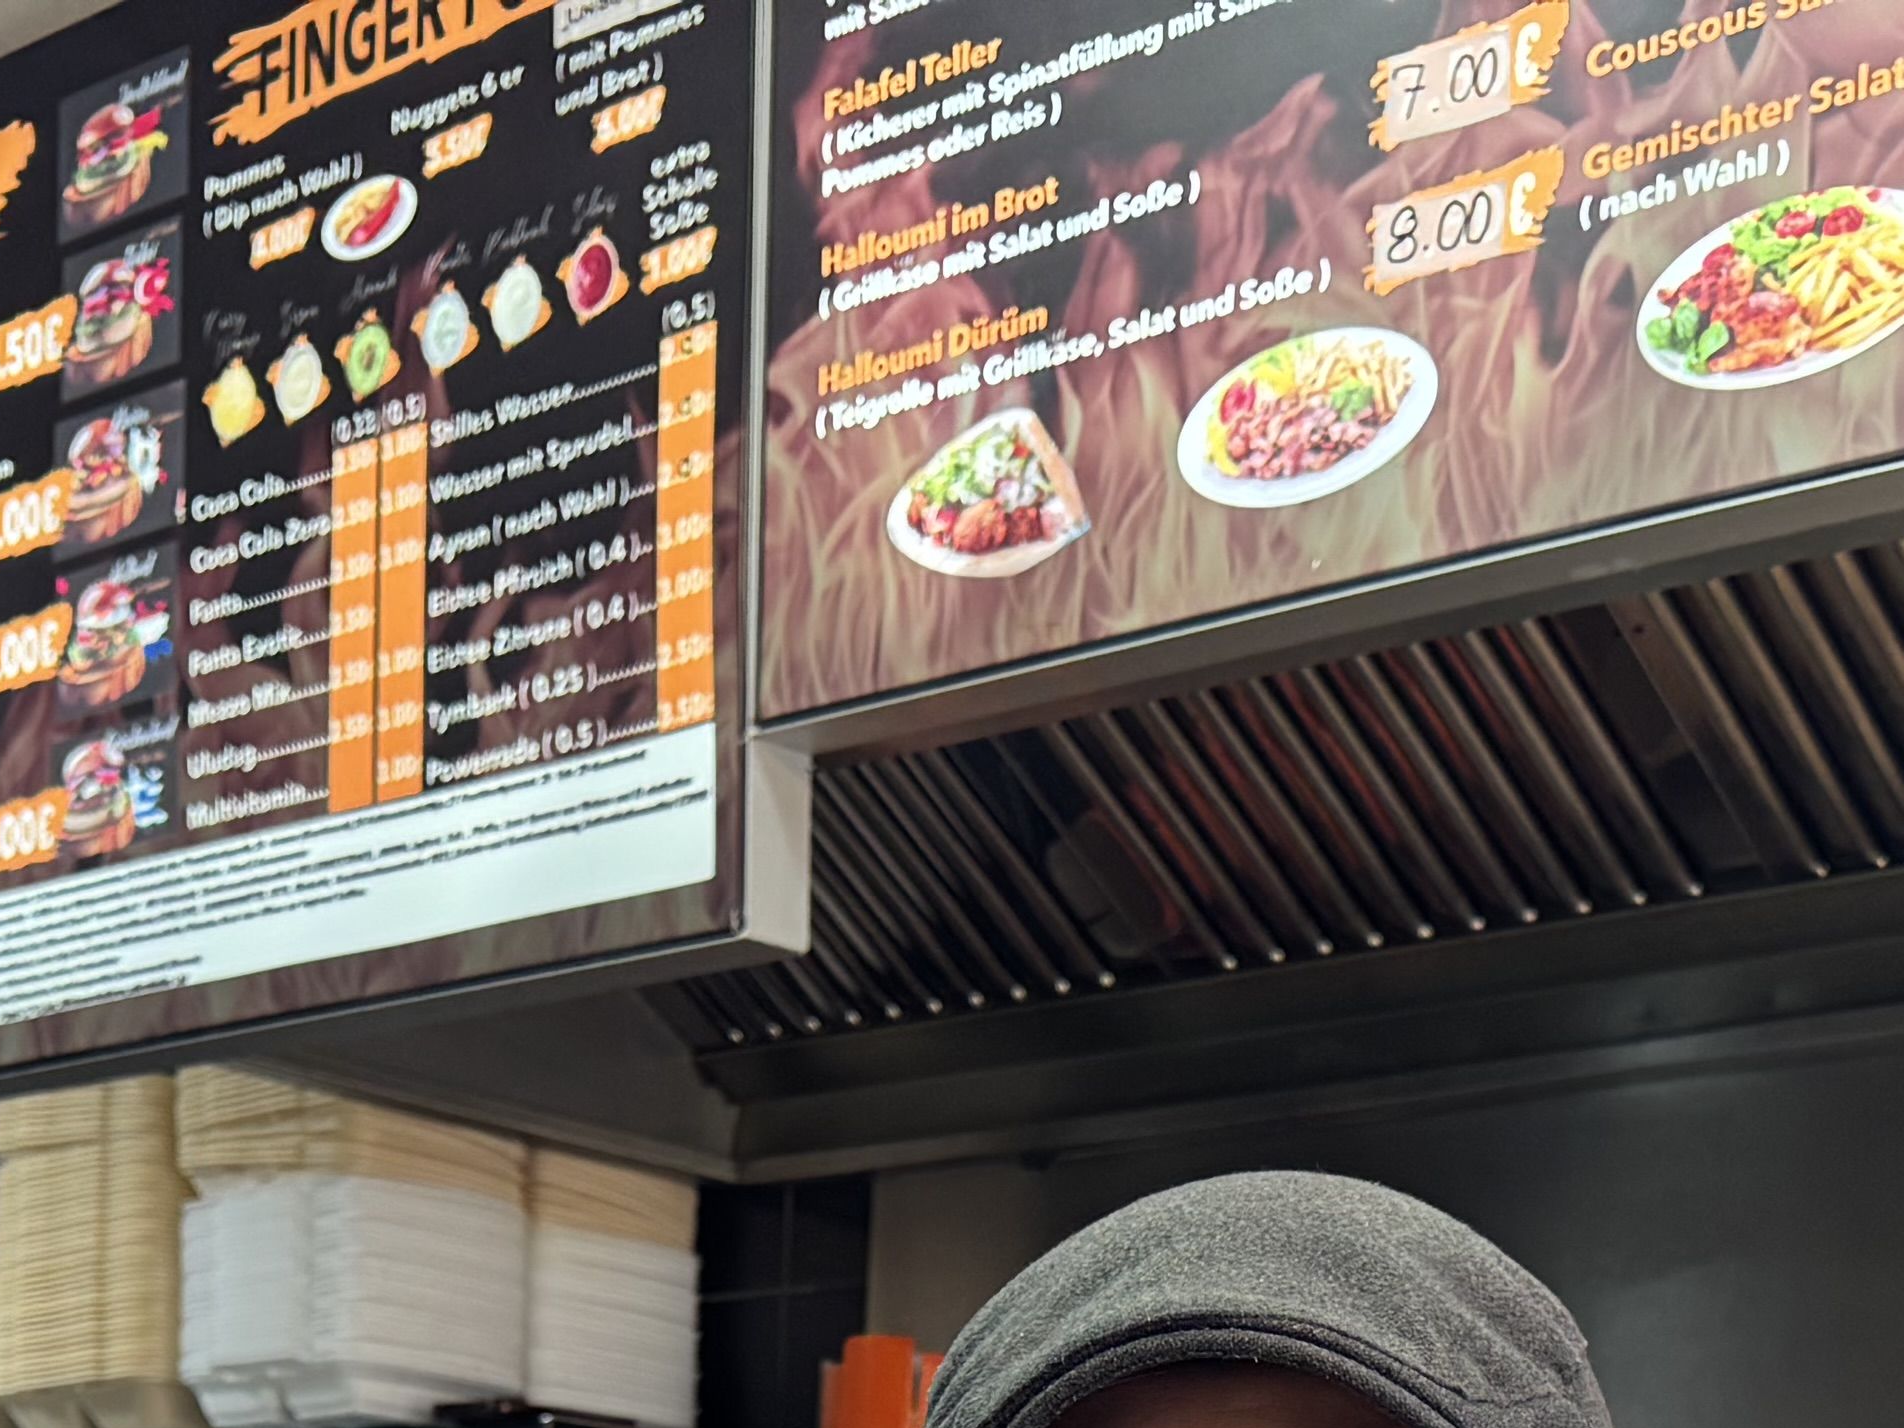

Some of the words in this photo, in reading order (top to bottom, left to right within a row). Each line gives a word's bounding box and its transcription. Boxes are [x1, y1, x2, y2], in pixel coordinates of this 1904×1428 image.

[609, 3, 705, 58] Pommes
[942, 81, 986, 120] mit
[987, 22, 1164, 106] Spinatfüllung
[1168, 2, 1216, 40] mit
[1586, 1, 1770, 77] Couscous
[391, 83, 479, 136] Nuggets
[555, 75, 599, 116] und
[601, 59, 650, 98] Brot
[824, 58, 917, 121] Falafel
[920, 37, 1003, 86] Teller
[650, 140, 711, 180] extra
[822, 144, 925, 198] Pommes
[927, 123, 988, 163] oder
[991, 100, 1047, 141] Reis
[1582, 93, 1802, 180] Gemischter
[203, 153, 286, 202] Pommes
[642, 167, 719, 214] Schale
[1599, 173, 1677, 221] nach
[1682, 142, 1769, 196] Wahl
[821, 207, 948, 278] Halloumi
[952, 202, 990, 237] im
[994, 175, 1059, 222] Brot
[832, 254, 940, 312] Grillkäse
[943, 240, 987, 279] mit
[988, 220, 1054, 264] Salat
[1056, 197, 1110, 243] und
[1113, 179, 1184, 224] Soße
[818, 328, 944, 397] Halloumi
[948, 305, 1049, 359] Dürüm
[828, 377, 935, 430] Teigrolle
[937, 362, 982, 400] mit
[1107, 305, 1176, 349] Salat
[1179, 283, 1236, 328] und
[1239, 266, 1313, 311] Soße
[429, 462, 505, 504] Wasser
[507, 446, 544, 480] mit
[546, 413, 632, 471] Sprudel
[192, 490, 240, 521] Coca
[428, 524, 491, 564] Ayran
[505, 498, 557, 538] nach
[559, 476, 616, 521] Wahl
[190, 543, 239, 574] Coca
[239, 524, 285, 559] Cola
